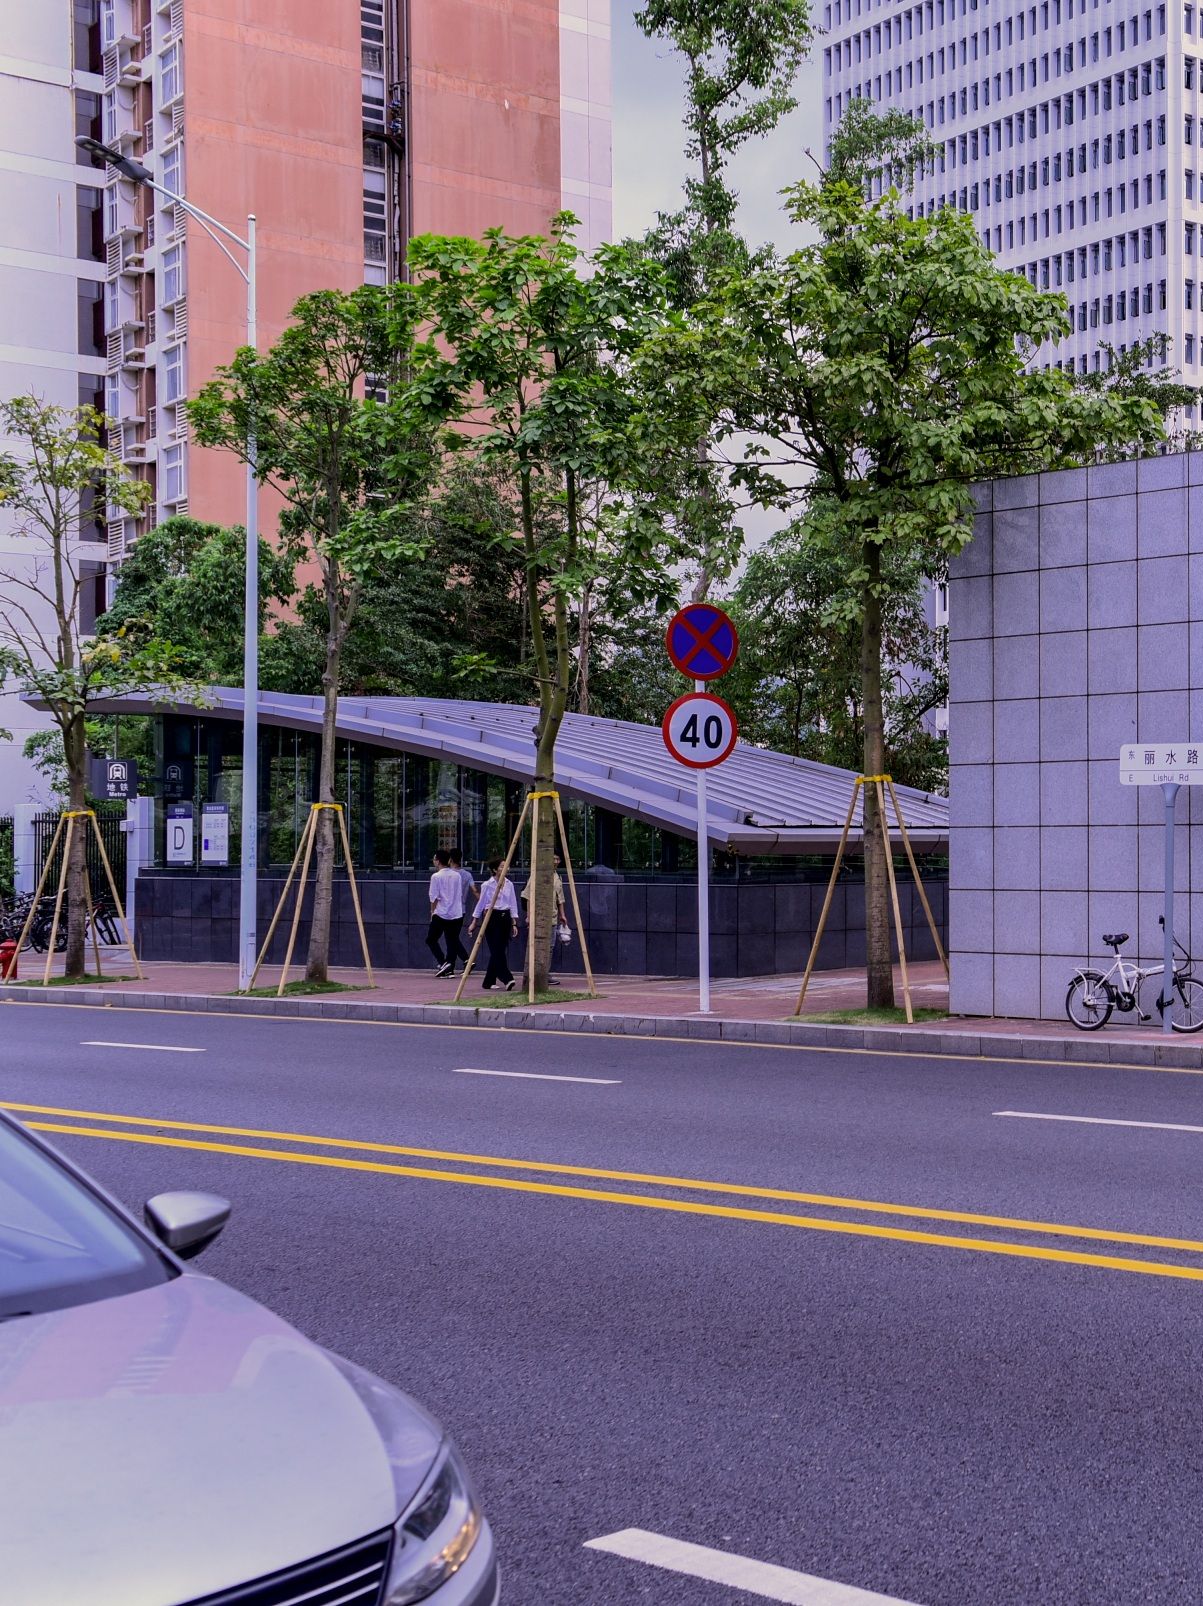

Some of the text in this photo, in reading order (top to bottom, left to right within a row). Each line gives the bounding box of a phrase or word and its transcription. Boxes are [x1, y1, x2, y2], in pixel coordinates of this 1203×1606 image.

[680, 713, 723, 749] 40
[1128, 750, 1136, 760] 东
[1143, 749, 1199, 765] 丽水路
[1128, 774, 1134, 782] E
[1153, 773, 1175, 782] Lishui
[1179, 773, 1189, 782] Rd
[107, 783, 129, 791] 地铁
[174, 825, 185, 850] D
